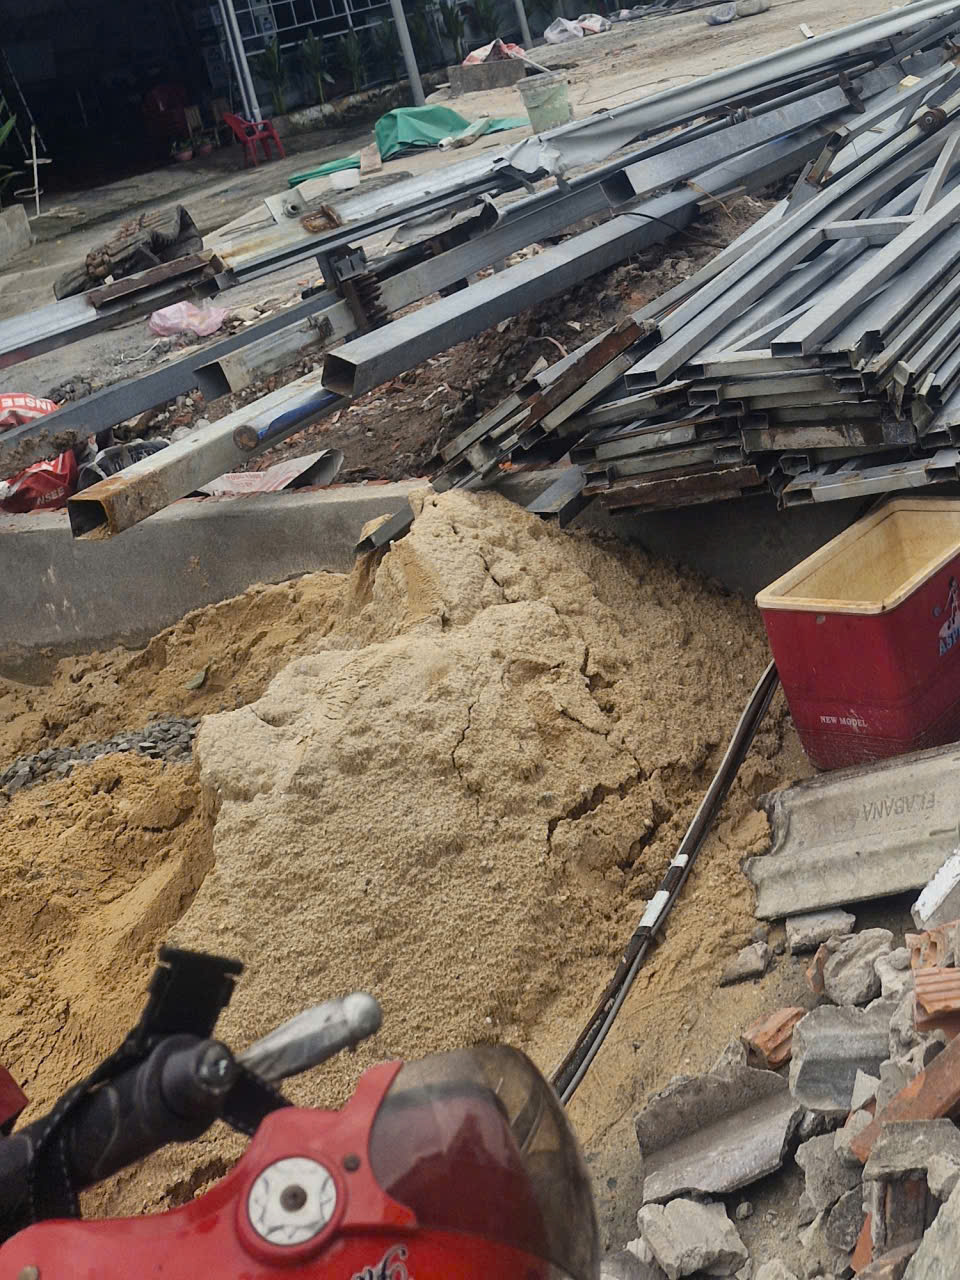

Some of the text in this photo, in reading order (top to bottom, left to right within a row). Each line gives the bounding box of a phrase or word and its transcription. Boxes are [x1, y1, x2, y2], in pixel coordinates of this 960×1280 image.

[2, 397, 52, 412] INSEE
[36, 486, 65, 505] NSEE
[820, 715, 868, 728] NEW MODEL
